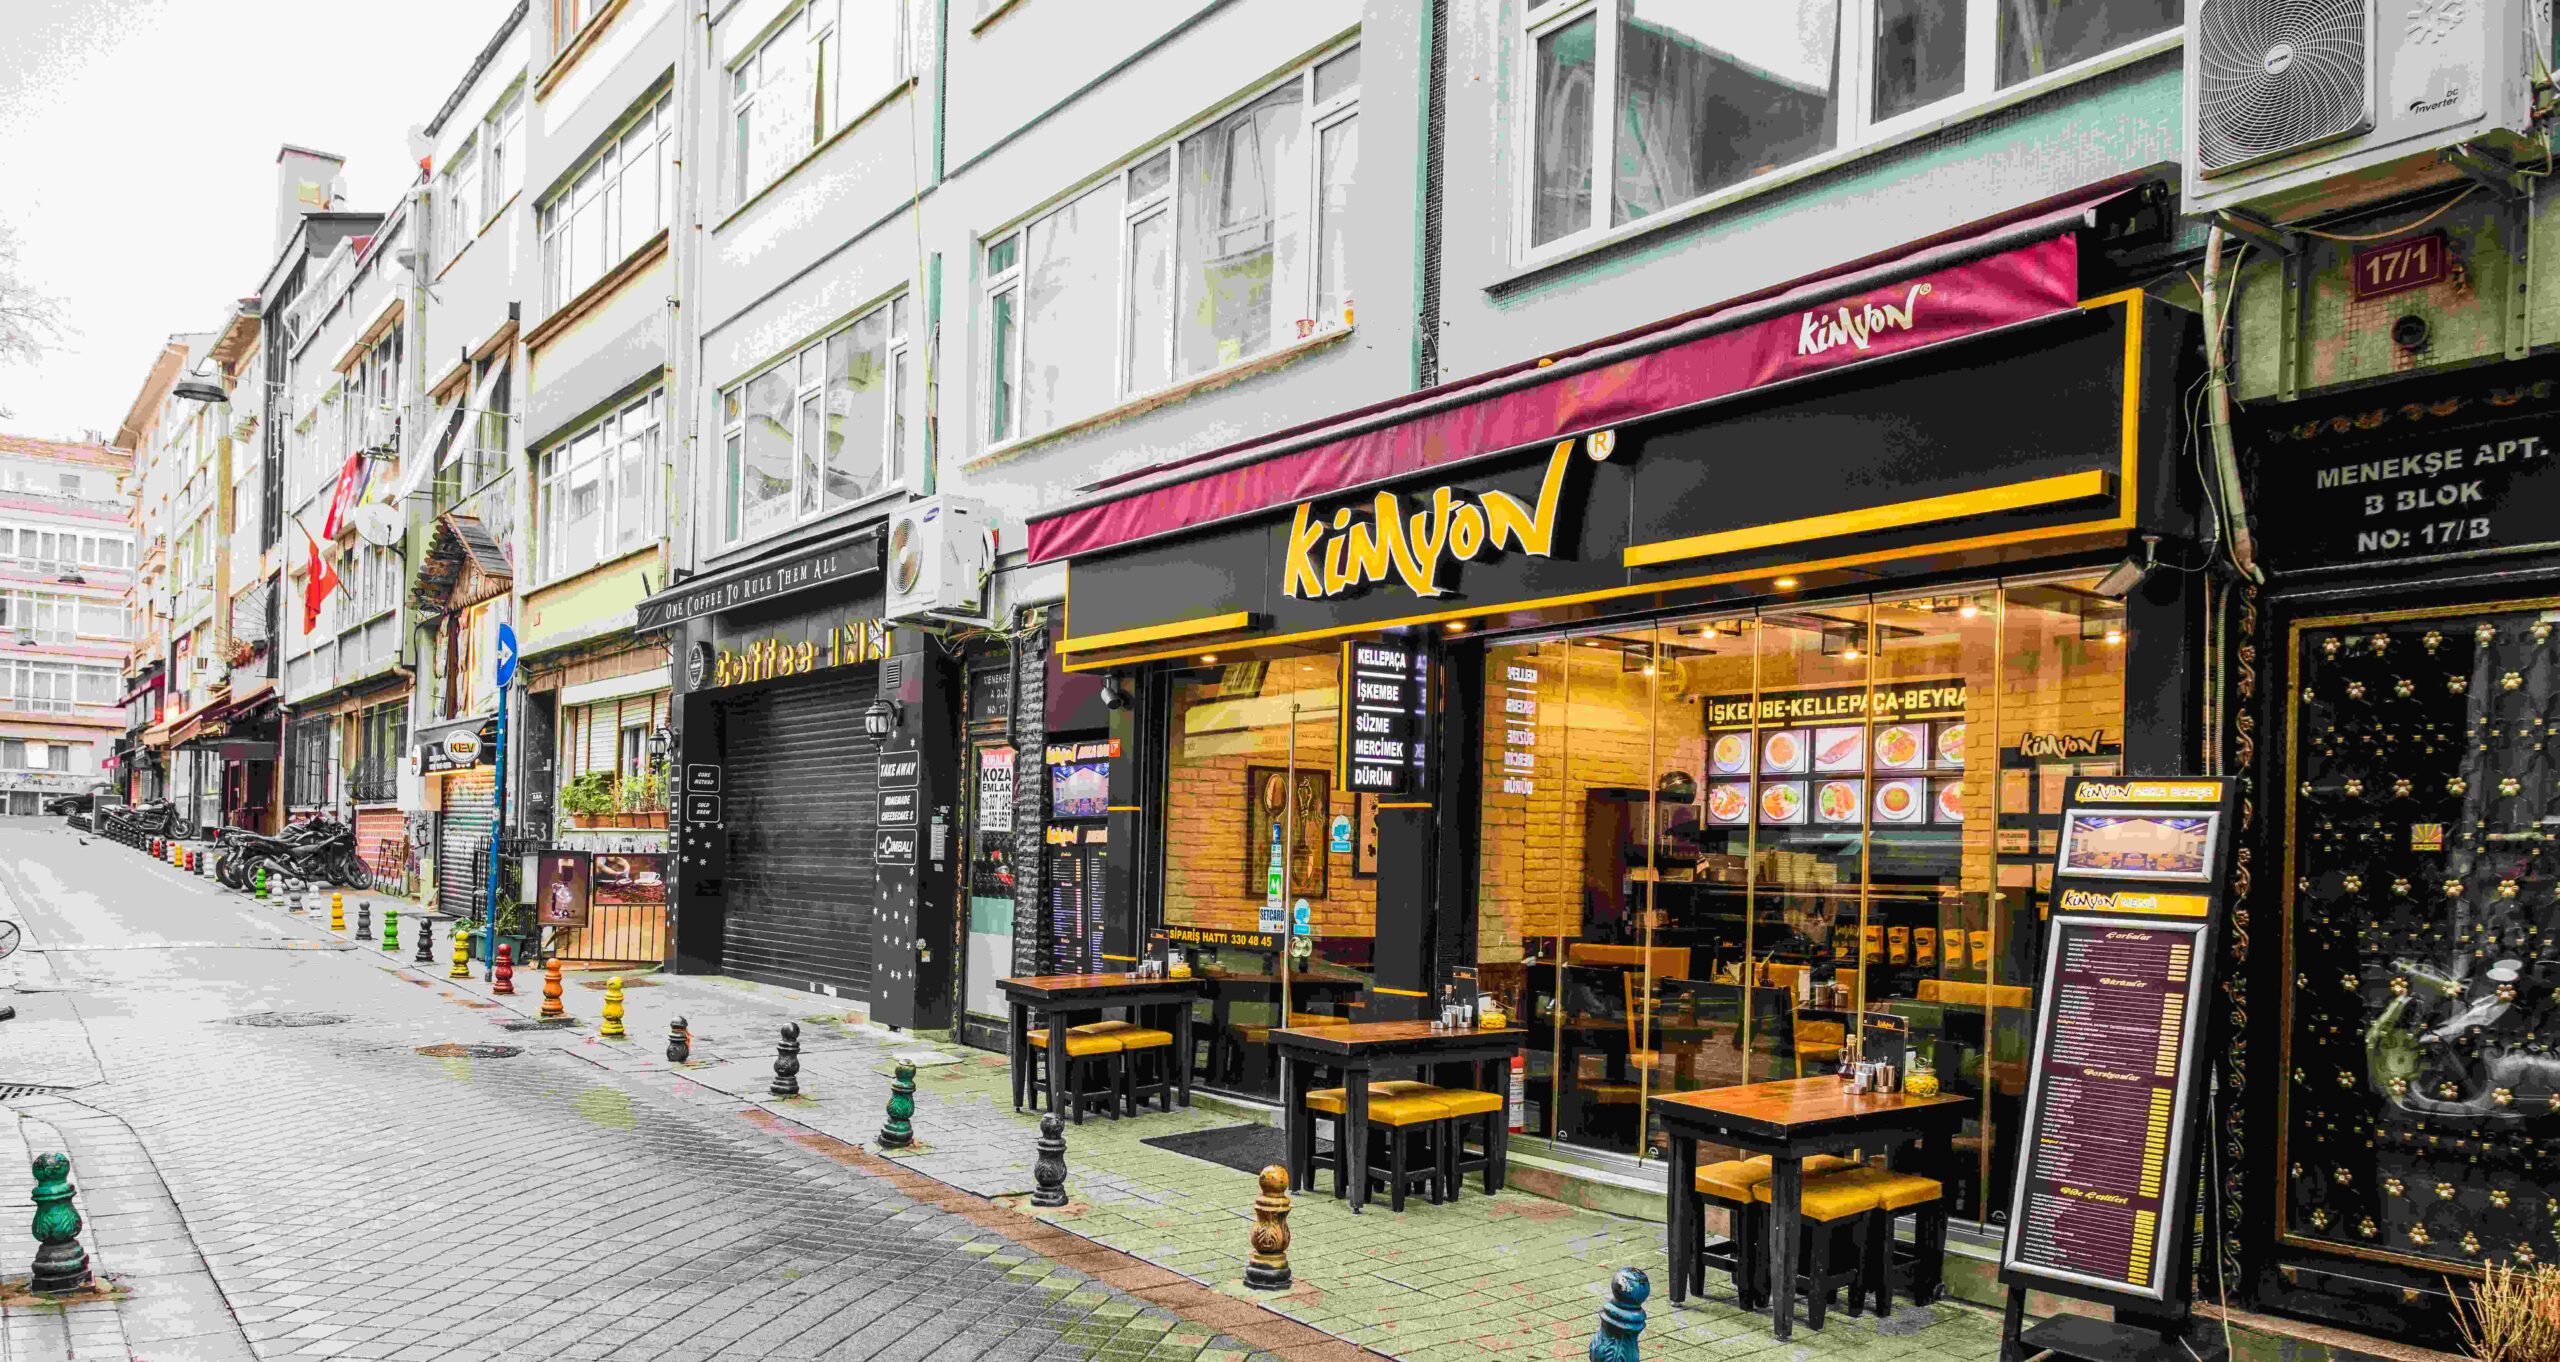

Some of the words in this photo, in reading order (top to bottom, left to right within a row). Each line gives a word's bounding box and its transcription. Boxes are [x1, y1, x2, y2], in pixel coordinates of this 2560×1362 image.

[2446, 88, 2459, 98] DC
[2414, 96, 2459, 115] Inverter
[2366, 243, 2428, 285] 17/1
[2316, 448, 2463, 489] MENEKŞE
[2473, 436, 2549, 466] APT.
[2364, 495, 2384, 516] B
[2396, 480, 2483, 511] BLOK
[2357, 528, 2411, 553] NO:
[2421, 517, 2490, 545] 17/B
[665, 602, 683, 620] ONE
[687, 589, 722, 617] COFFEE
[726, 584, 739, 606] TO
[744, 575, 772, 598] RULE
[777, 566, 807, 592] THEM
[814, 556, 837, 580] ALL
[1358, 648, 1407, 672] KELLEPAÇA
[1357, 679, 1399, 702] İŞKEMBE
[1356, 712, 1390, 733] SÜZME
[1355, 737, 1404, 757] MERCİMEK
[880, 763, 897, 777] TAKE
[895, 762, 917, 776] AWAY
[982, 768, 1012, 782] KOZA
[1354, 765, 1392, 786] DÜRÜM
[982, 783, 1011, 792] EMLAK
[1260, 908, 1285, 922] SETCARD
[1169, 926, 1201, 944] SİPARİŞ
[1202, 931, 1228, 944] HATTI
[1230, 934, 1247, 945] 330
[1247, 934, 1259, 946] 48
[1260, 935, 1272, 947] 45
